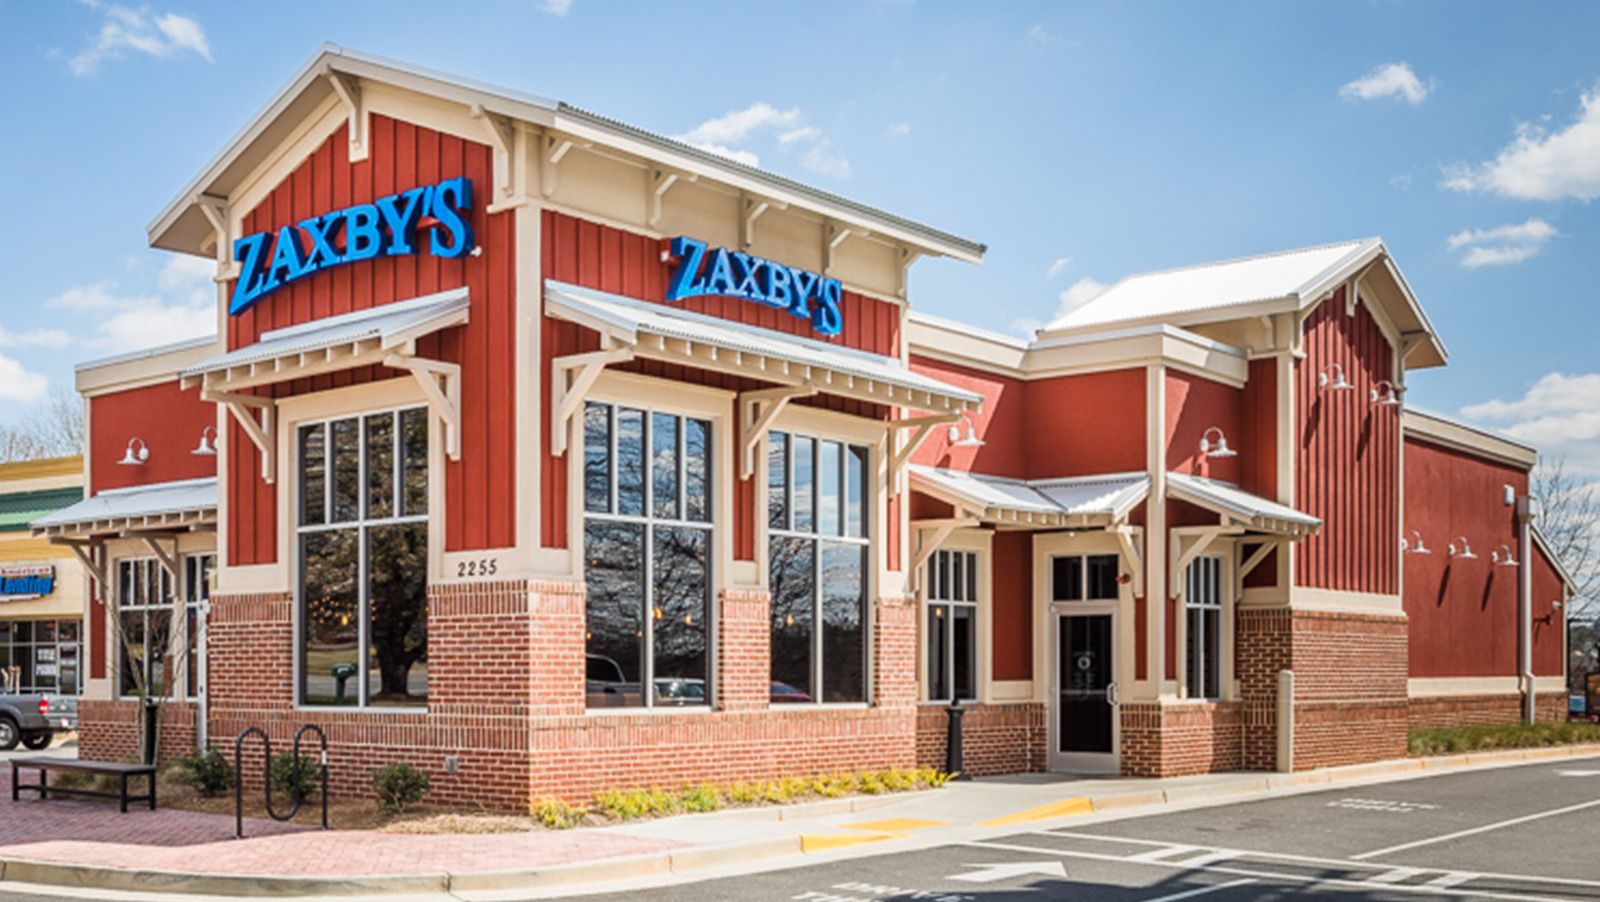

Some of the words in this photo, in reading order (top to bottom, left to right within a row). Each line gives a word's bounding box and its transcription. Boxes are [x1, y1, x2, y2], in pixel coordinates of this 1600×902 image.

[229, 176, 474, 316] ZAXBY'S
[665, 235, 842, 336] ZAXBY'S
[457, 558, 497, 577] 2255
